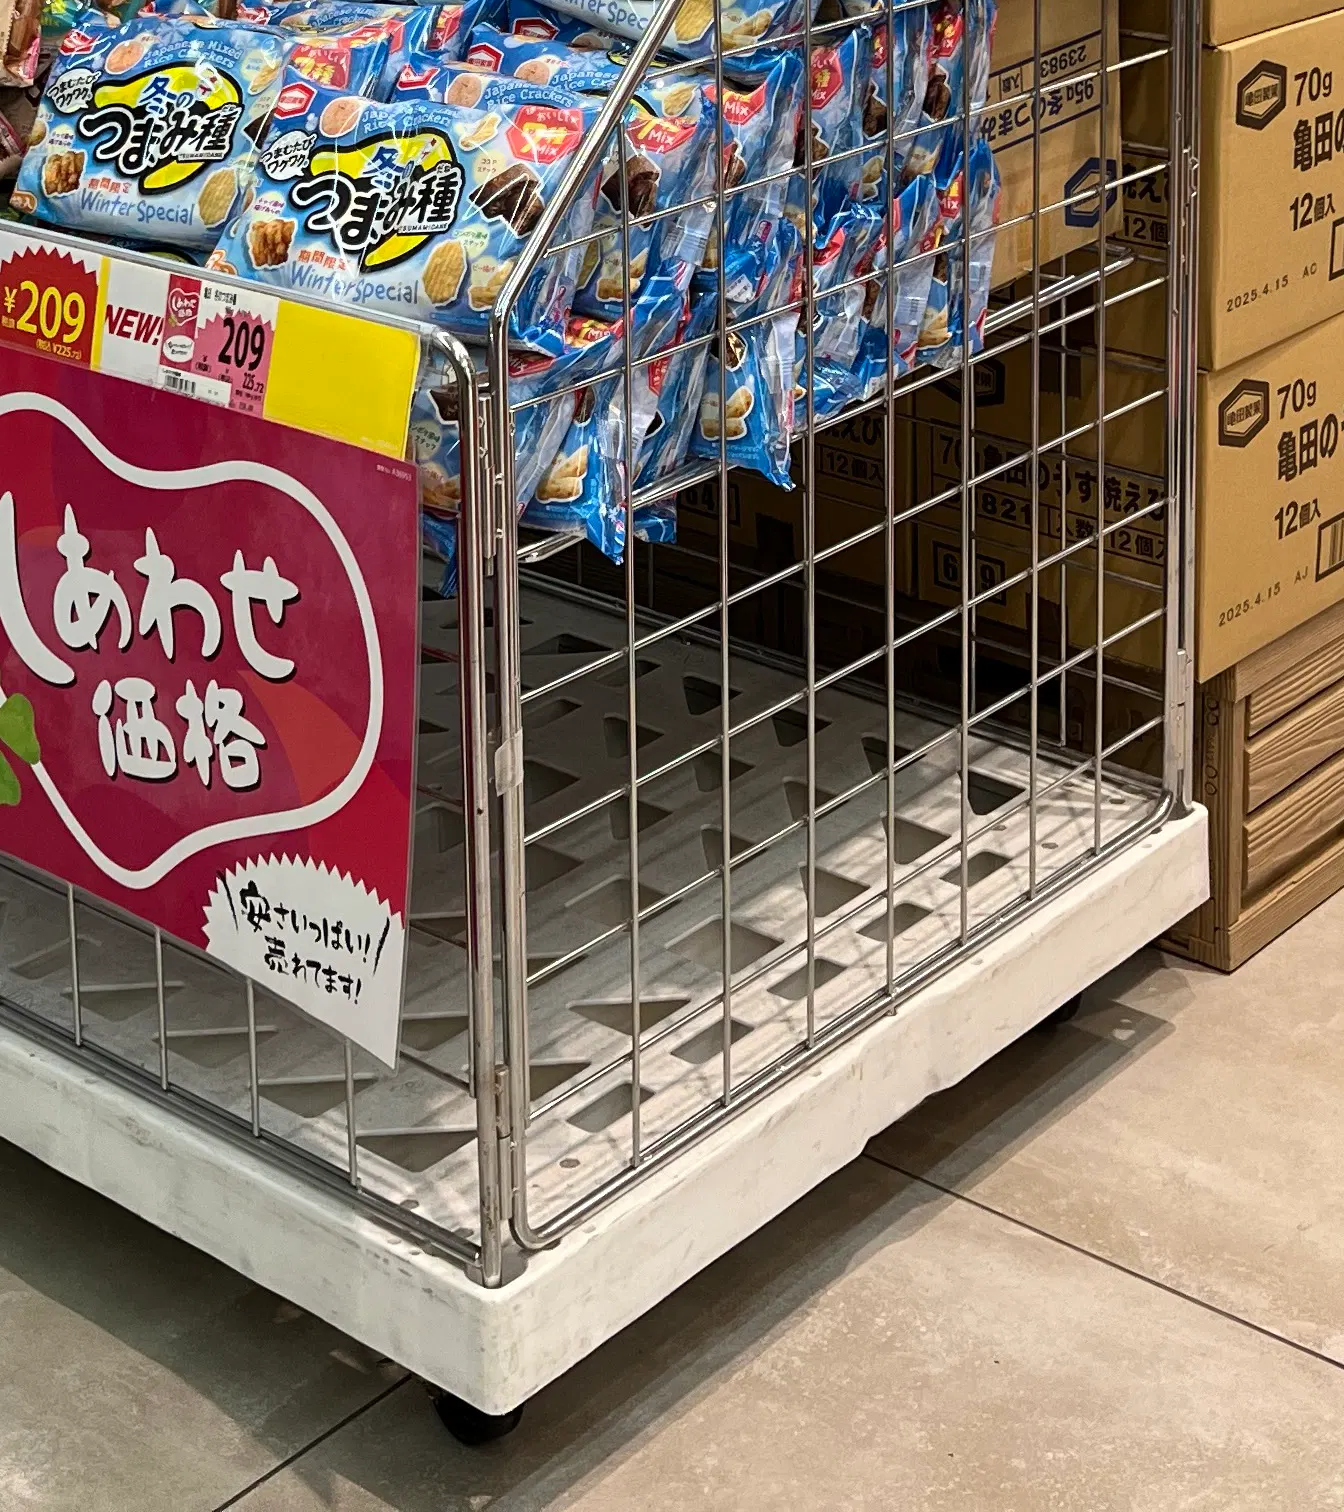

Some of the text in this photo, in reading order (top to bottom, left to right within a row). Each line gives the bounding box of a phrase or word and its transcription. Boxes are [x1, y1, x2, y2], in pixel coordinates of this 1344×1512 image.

[140, 76, 195, 115] 冬の
[520, 89, 573, 108] Crackers
[1294, 68, 1333, 107] 70g
[81, 105, 240, 174] つまみ種
[262, 137, 314, 159] つまむたび
[81, 189, 195, 226] Winter Special
[293, 169, 461, 249] つまみ種
[1290, 194, 1336, 231] 12個入
[291, 263, 419, 305] Winter Special
[1227, 275, 1289, 312] 2025.4.15
[4, 281, 86, 344] ¥209
[105, 303, 164, 346] NEW!
[218, 317, 266, 371] 209
[1277, 378, 1317, 420] 70g
[1274, 498, 1322, 540] 12個入
[1218, 583, 1281, 627] 2025.4.15
[91, 677, 268, 788] 価格
